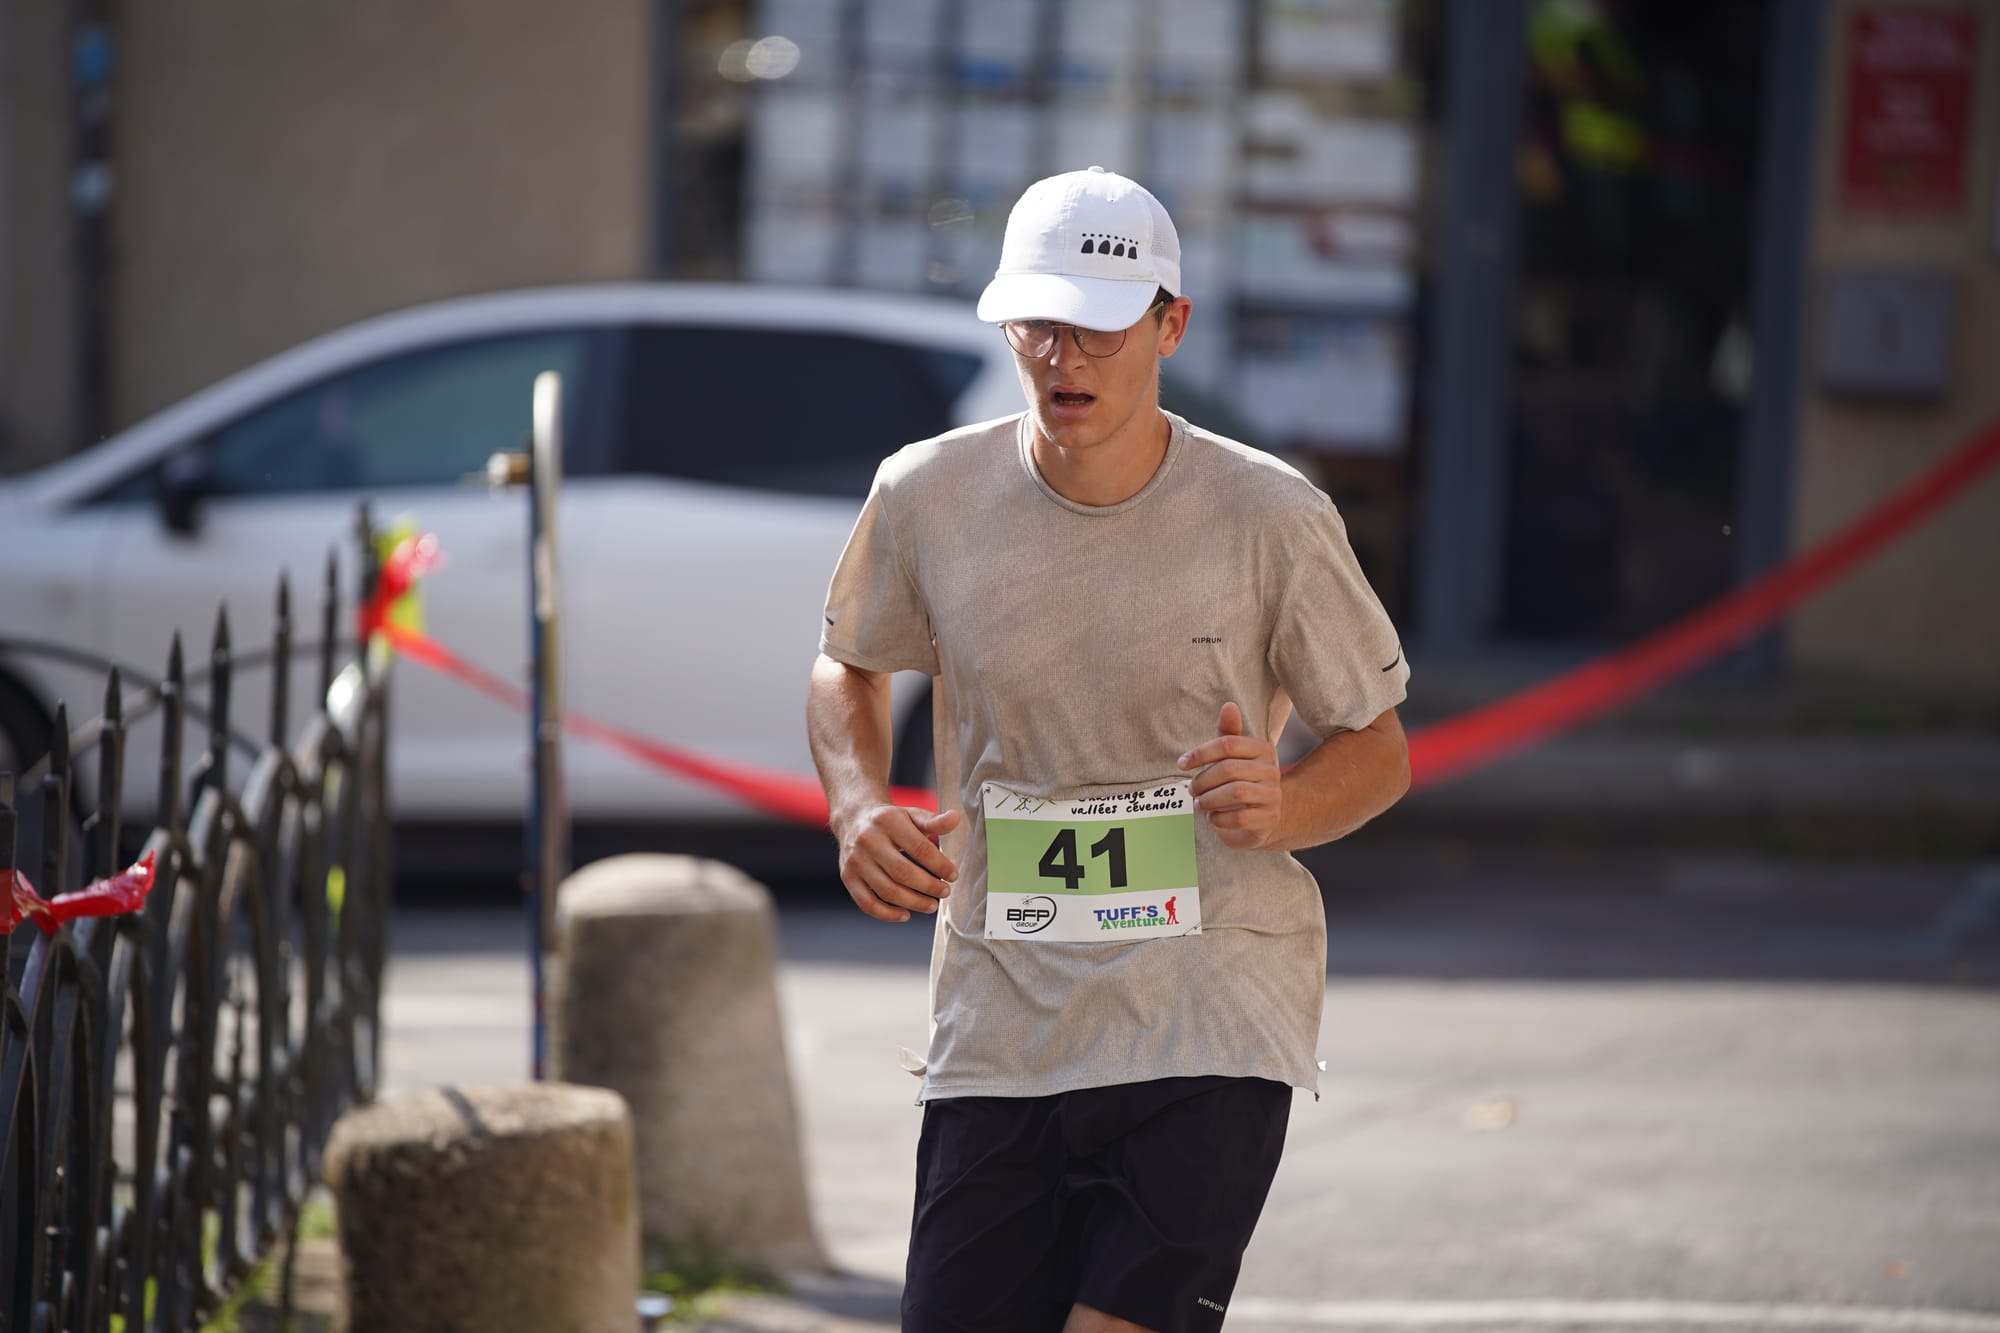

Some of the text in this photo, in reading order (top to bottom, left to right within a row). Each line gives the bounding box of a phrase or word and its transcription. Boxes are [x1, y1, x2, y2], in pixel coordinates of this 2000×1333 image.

[1153, 787, 1176, 798] des
[1071, 800, 1184, 815] vallées cévenoles
[1038, 827, 1128, 889] 41
[1006, 908, 1050, 922] BFP
[1093, 905, 1159, 922] TUFF'S
[1100, 916, 1166, 930] Aventure
[1197, 1296, 1225, 1312] KIPRUN
